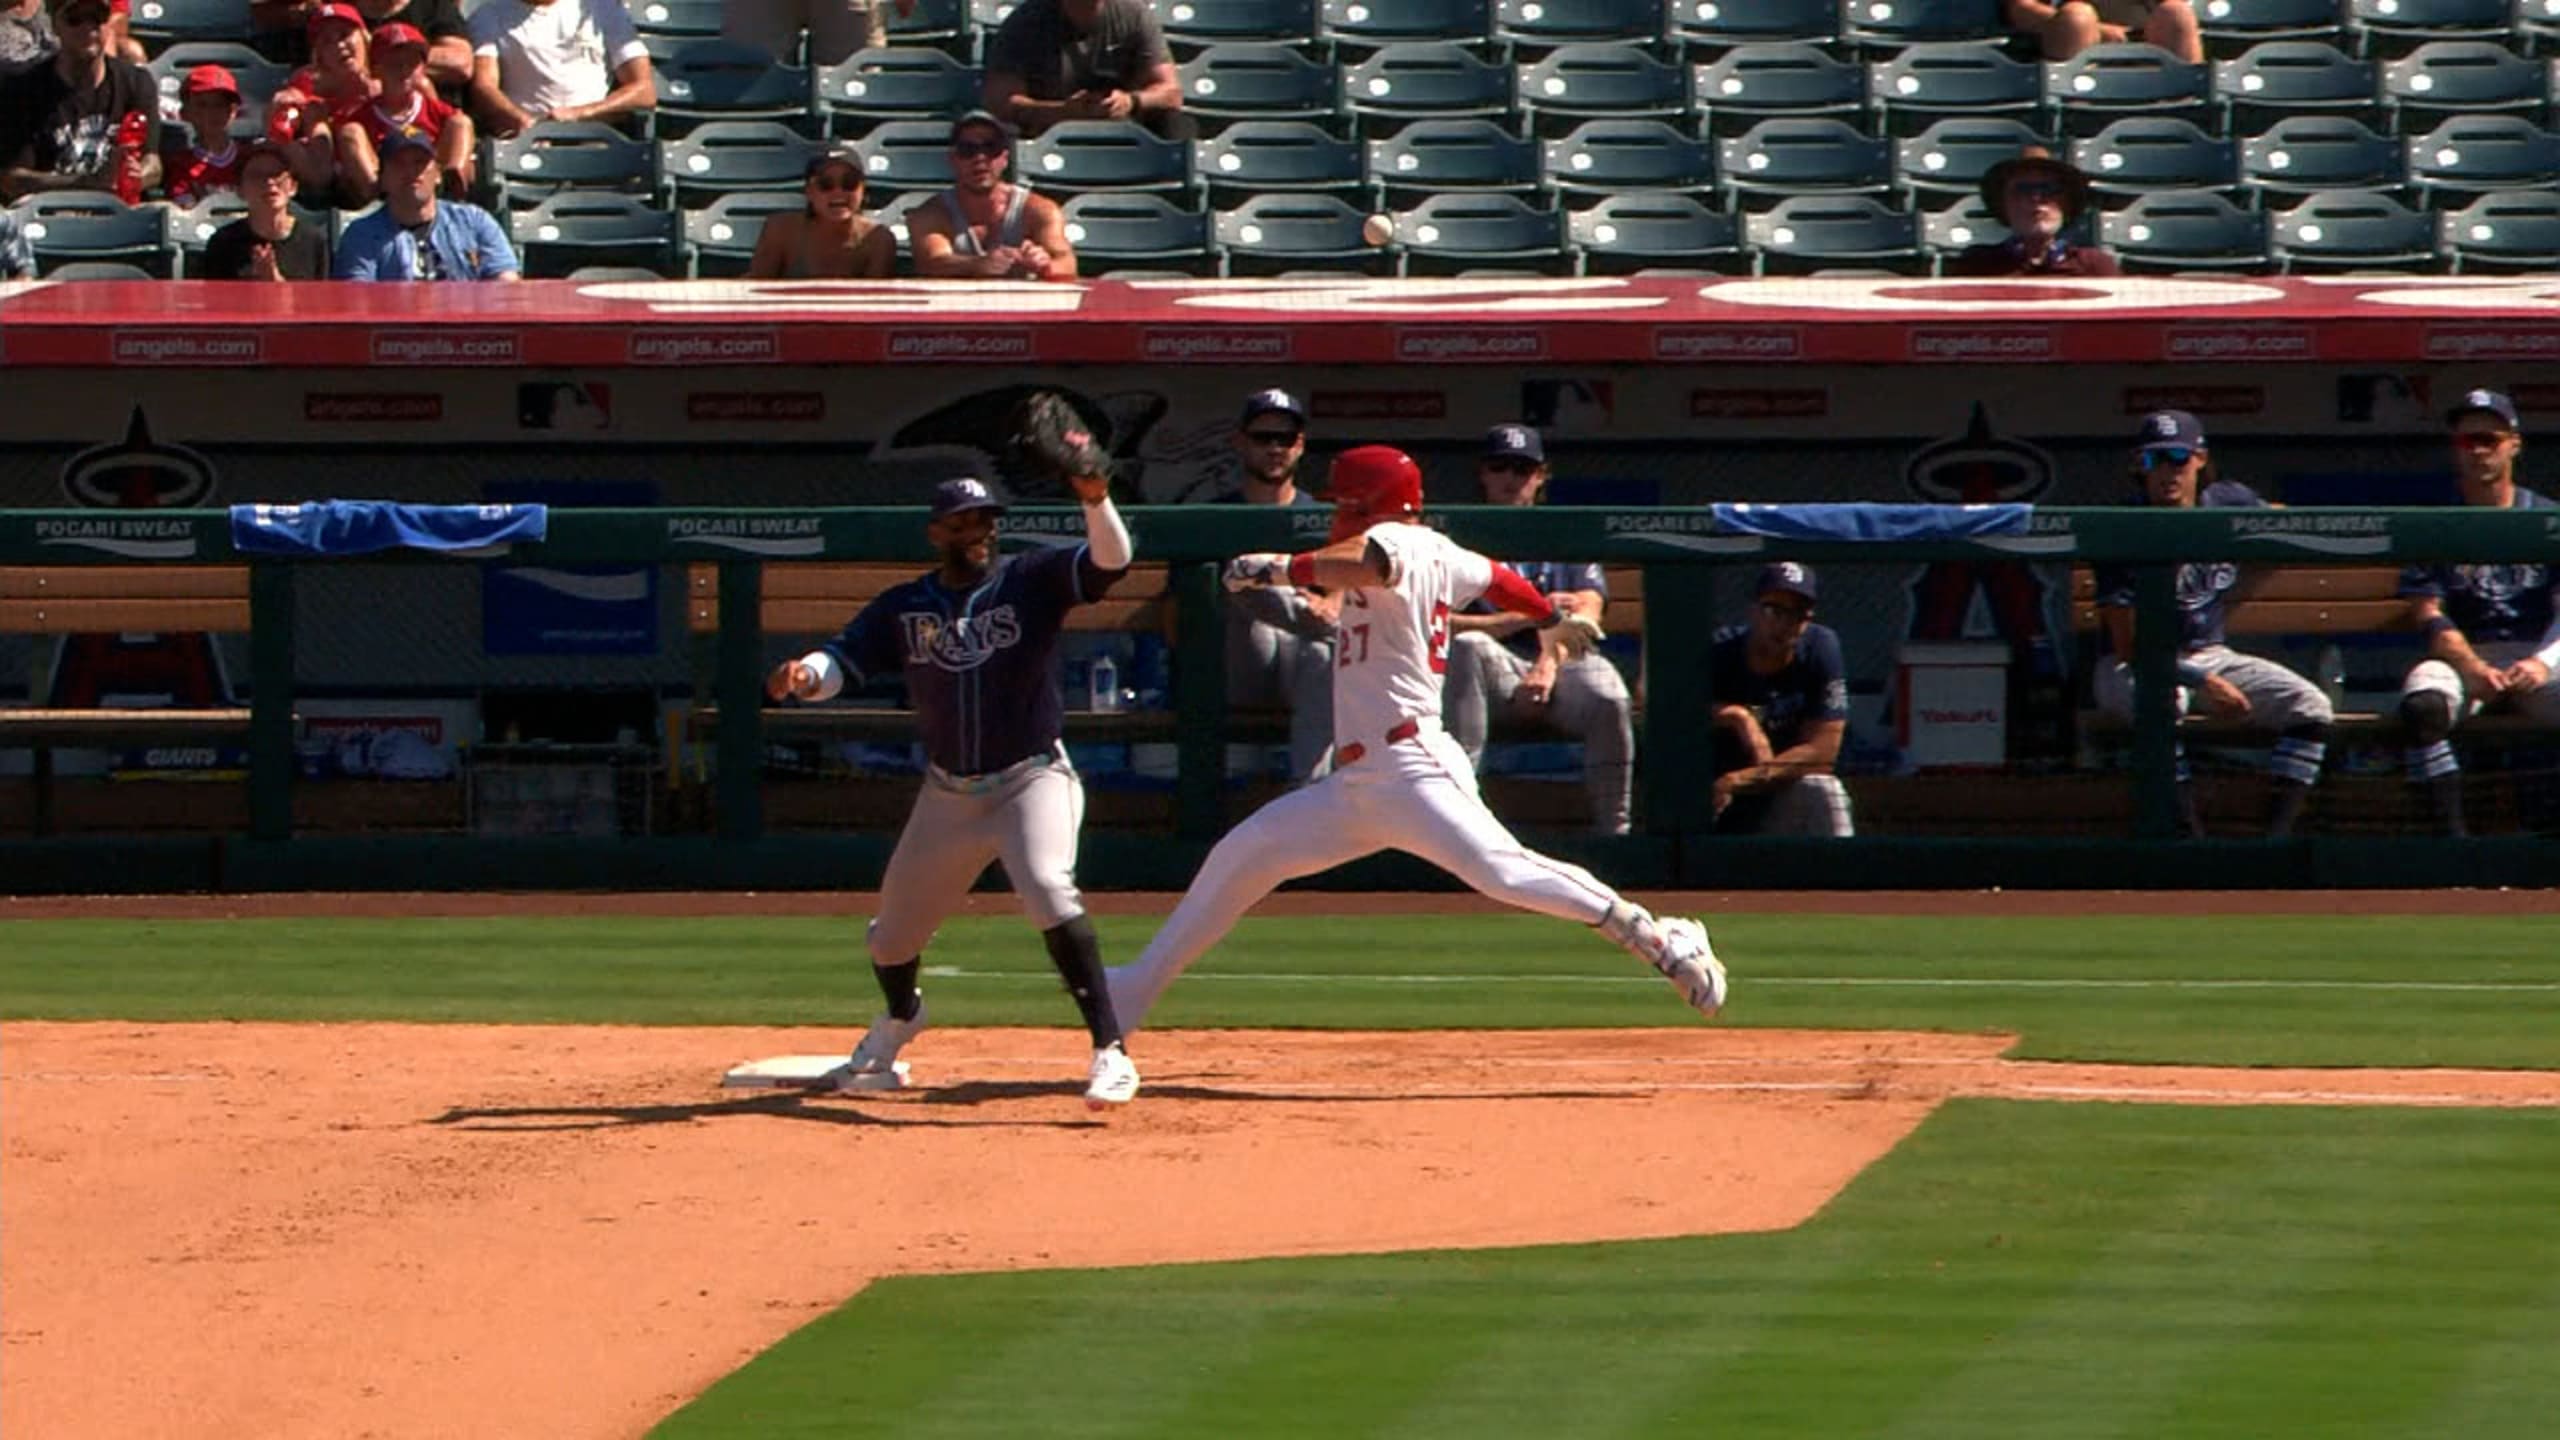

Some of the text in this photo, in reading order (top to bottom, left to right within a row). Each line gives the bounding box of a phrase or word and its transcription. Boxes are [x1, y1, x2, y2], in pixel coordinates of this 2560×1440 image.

[118, 338, 256, 360] angels.com
[379, 338, 513, 360] angels.com
[635, 337, 771, 359] angels.com
[892, 336, 1025, 356] angels.com
[1147, 336, 1281, 357] angels.com
[1403, 335, 1537, 357] angels.com
[1660, 335, 1793, 356] angels.com
[1916, 335, 2049, 356] angels.com
[2172, 334, 2305, 355] angels.com
[36, 519, 193, 537] POCARI SWEAT
[667, 518, 821, 536] POCARI SWEAT
[993, 517, 1063, 533] OCARI
[1604, 516, 1690, 532] POCARI
[2033, 515, 2072, 531] EAT
[2232, 516, 2389, 532] POCARI SWEAT
[900, 604, 1019, 671] RAYS
